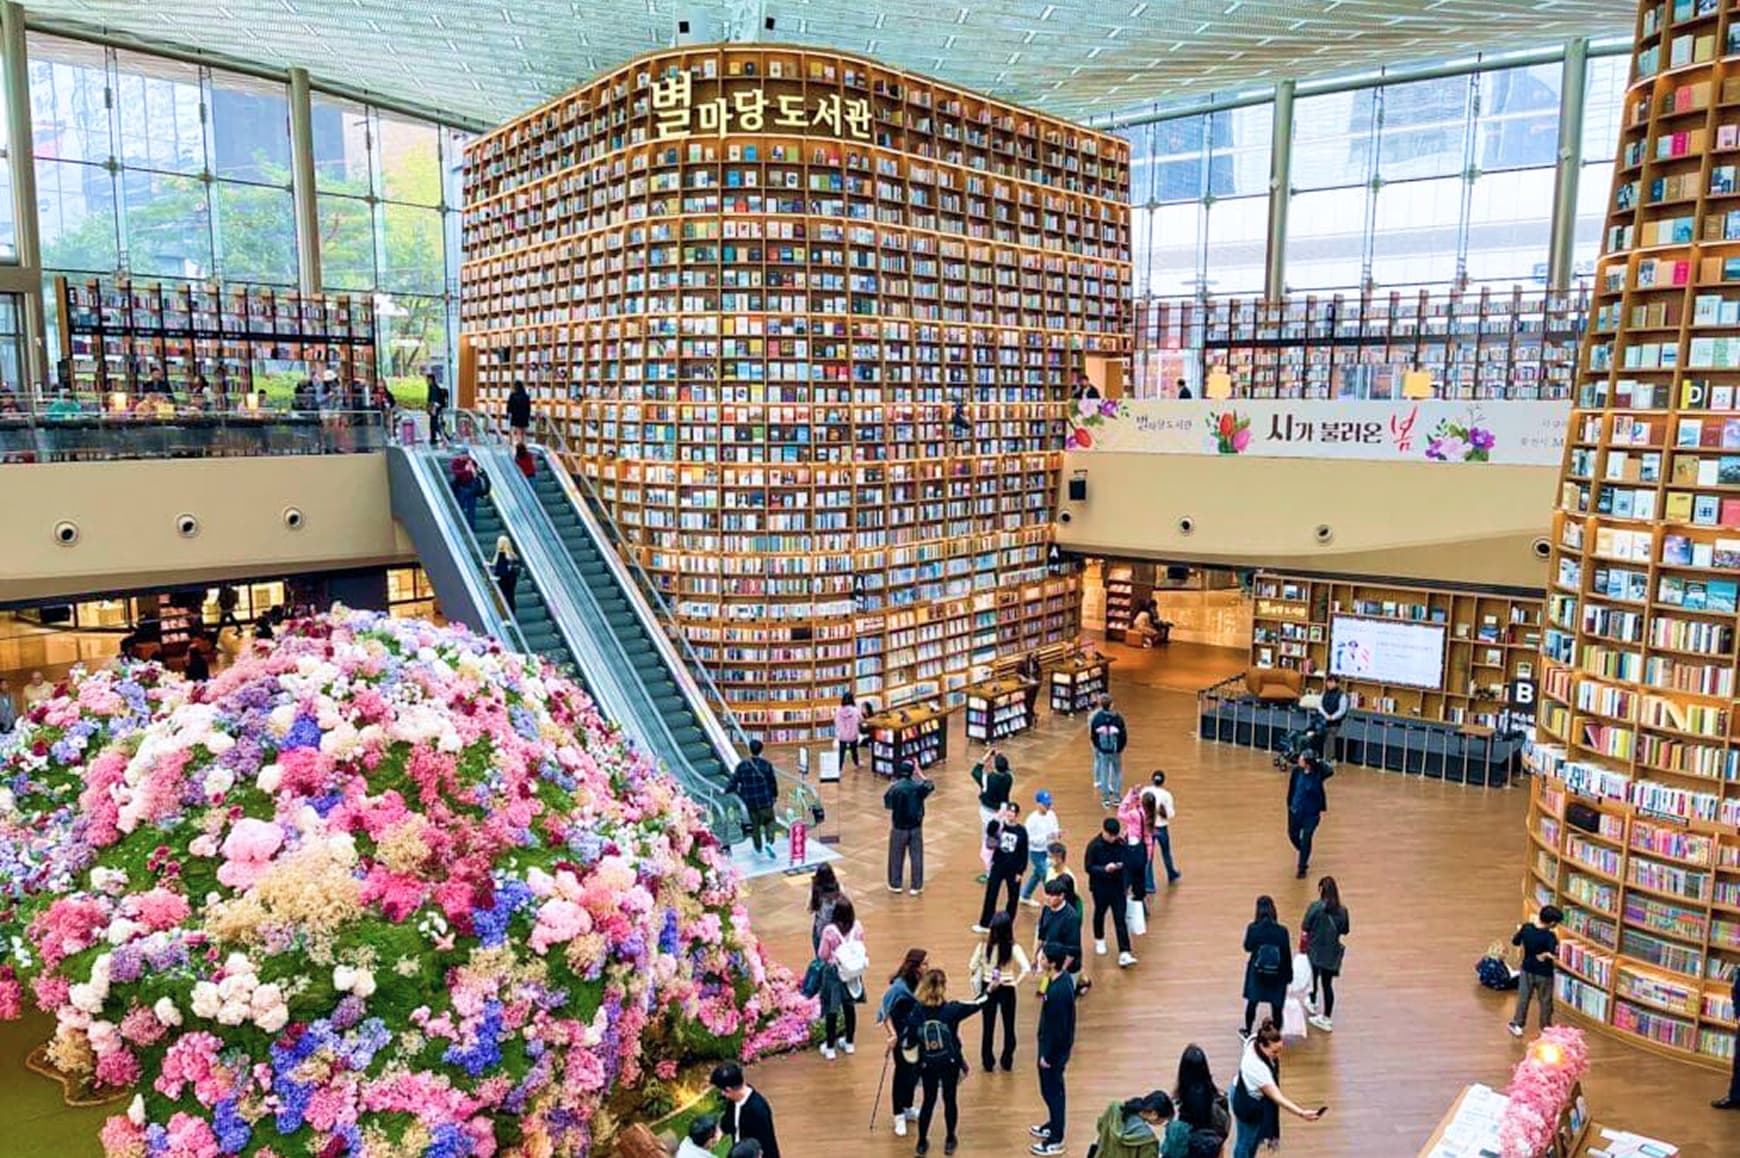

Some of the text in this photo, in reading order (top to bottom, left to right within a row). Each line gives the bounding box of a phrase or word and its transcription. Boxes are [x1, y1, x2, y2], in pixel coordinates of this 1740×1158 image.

[1267, 404, 1417, 451] 시가 불러온 봄
[1516, 682, 1533, 703] B
